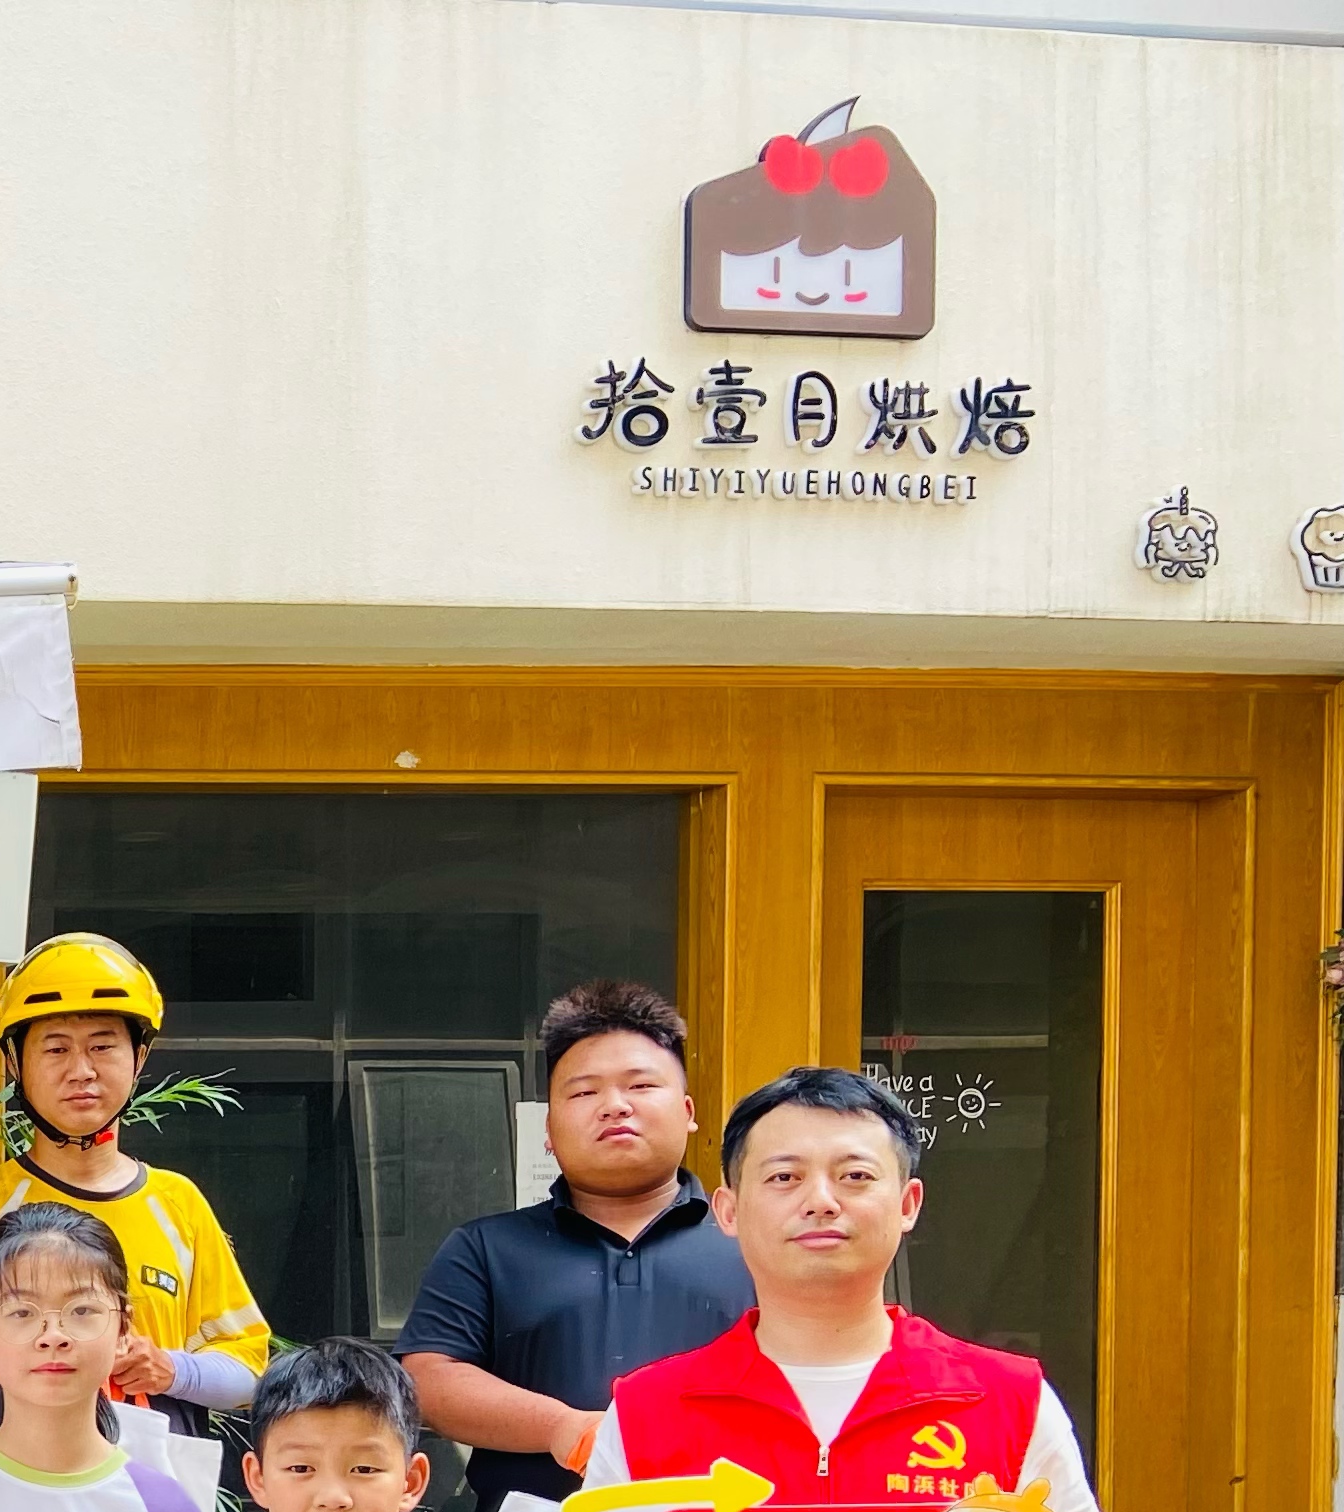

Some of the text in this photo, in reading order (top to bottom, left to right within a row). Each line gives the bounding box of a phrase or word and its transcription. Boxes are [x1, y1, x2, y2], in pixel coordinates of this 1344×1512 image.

[580, 357, 1036, 457] 拾壹月烘焙
[636, 466, 979, 502] SHIYIYUEHONGBEI
[918, 1074, 934, 1092] a
[914, 1125, 938, 1150] ay
